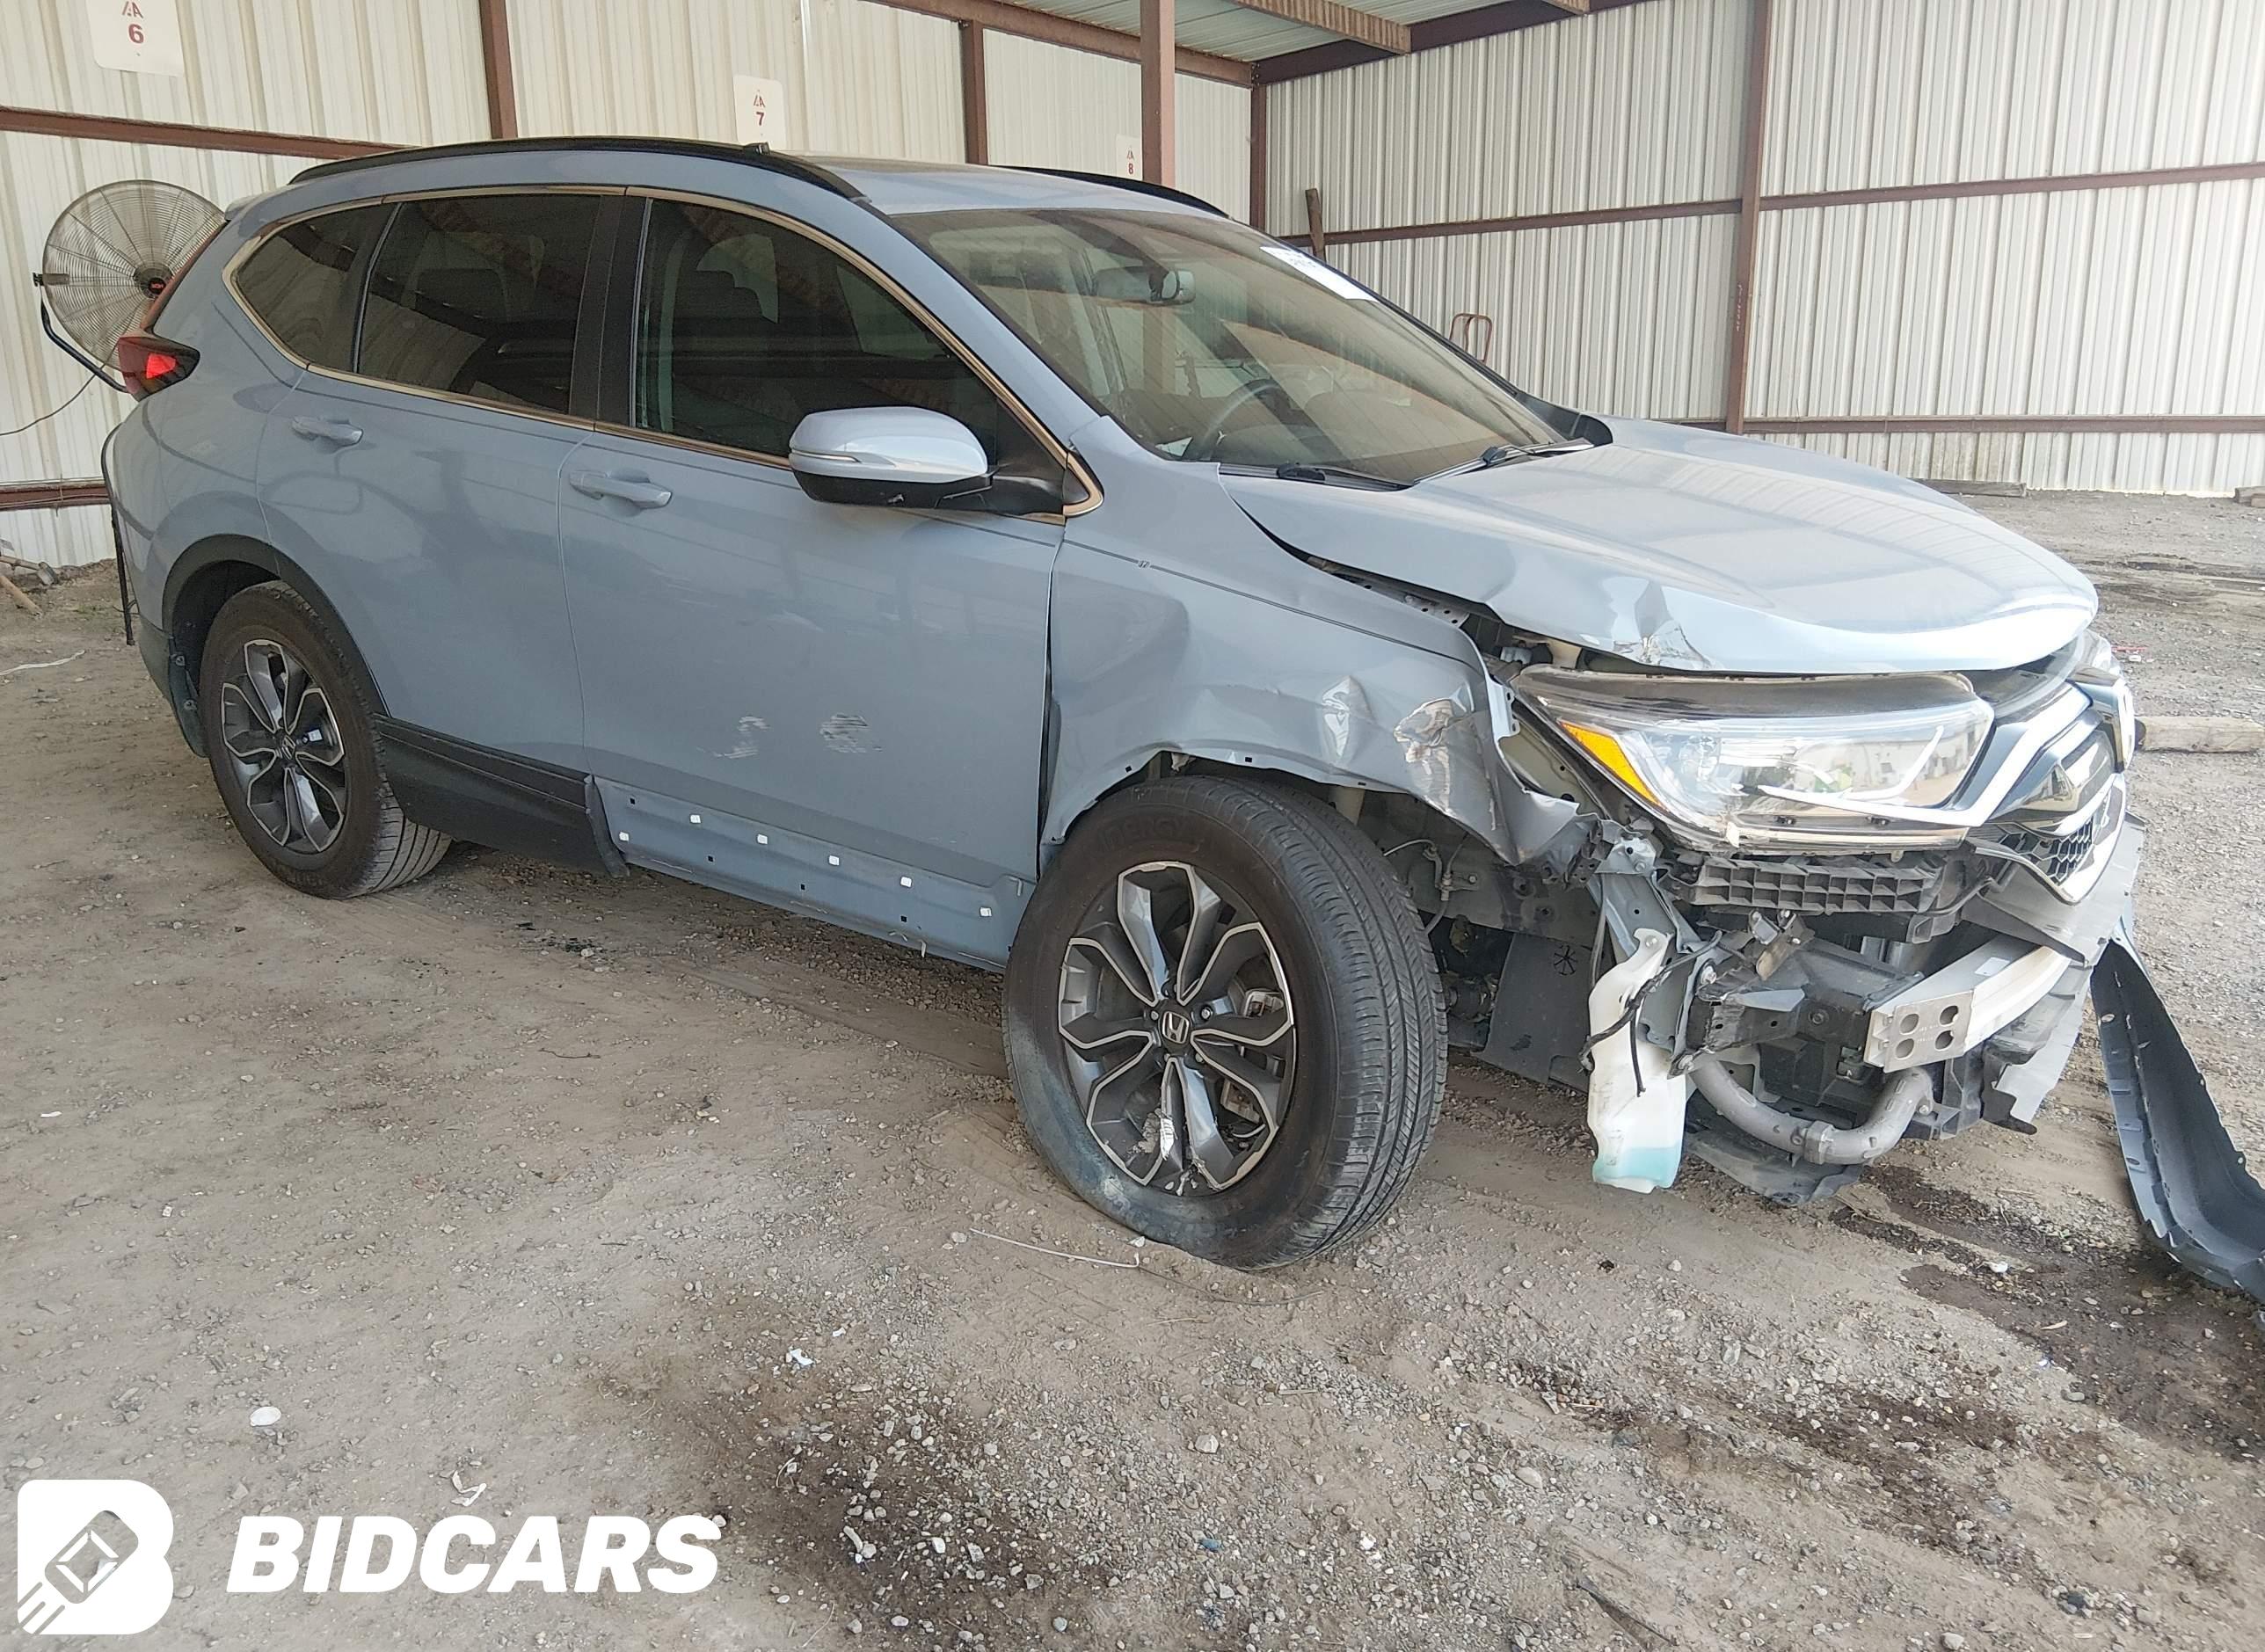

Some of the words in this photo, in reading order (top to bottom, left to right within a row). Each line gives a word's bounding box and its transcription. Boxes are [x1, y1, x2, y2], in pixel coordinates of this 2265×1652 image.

[128, 23, 144, 44] 6
[756, 111, 765, 126] 7
[1128, 163, 1134, 175] 8
